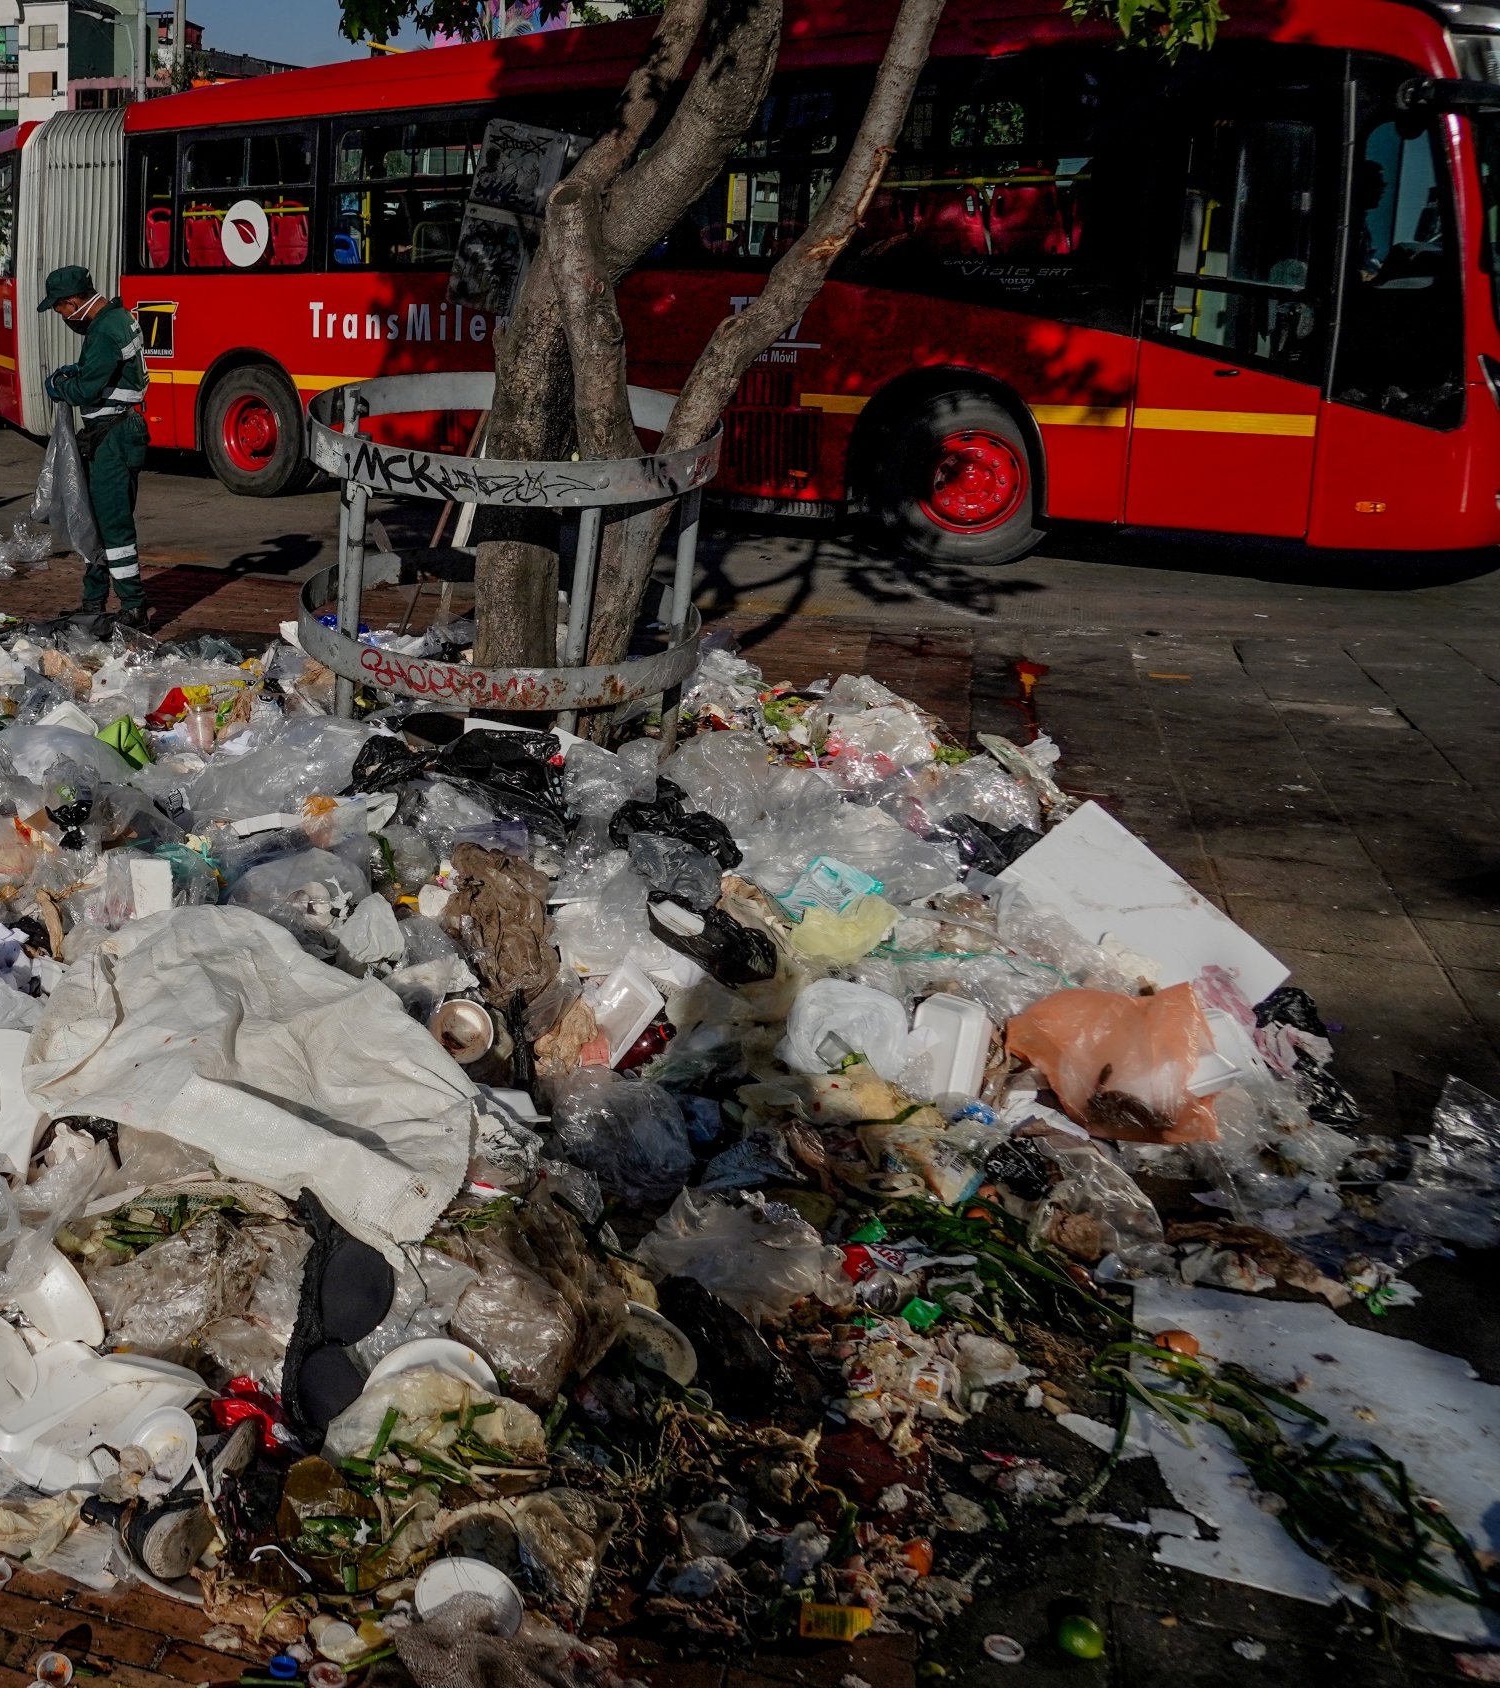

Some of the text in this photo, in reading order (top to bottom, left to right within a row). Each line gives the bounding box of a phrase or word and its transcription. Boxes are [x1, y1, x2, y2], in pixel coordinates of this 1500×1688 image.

[961, 264, 1031, 276] Viale
[1000, 277, 1036, 285] VOLVO
[770, 349, 797, 363] Móvil
